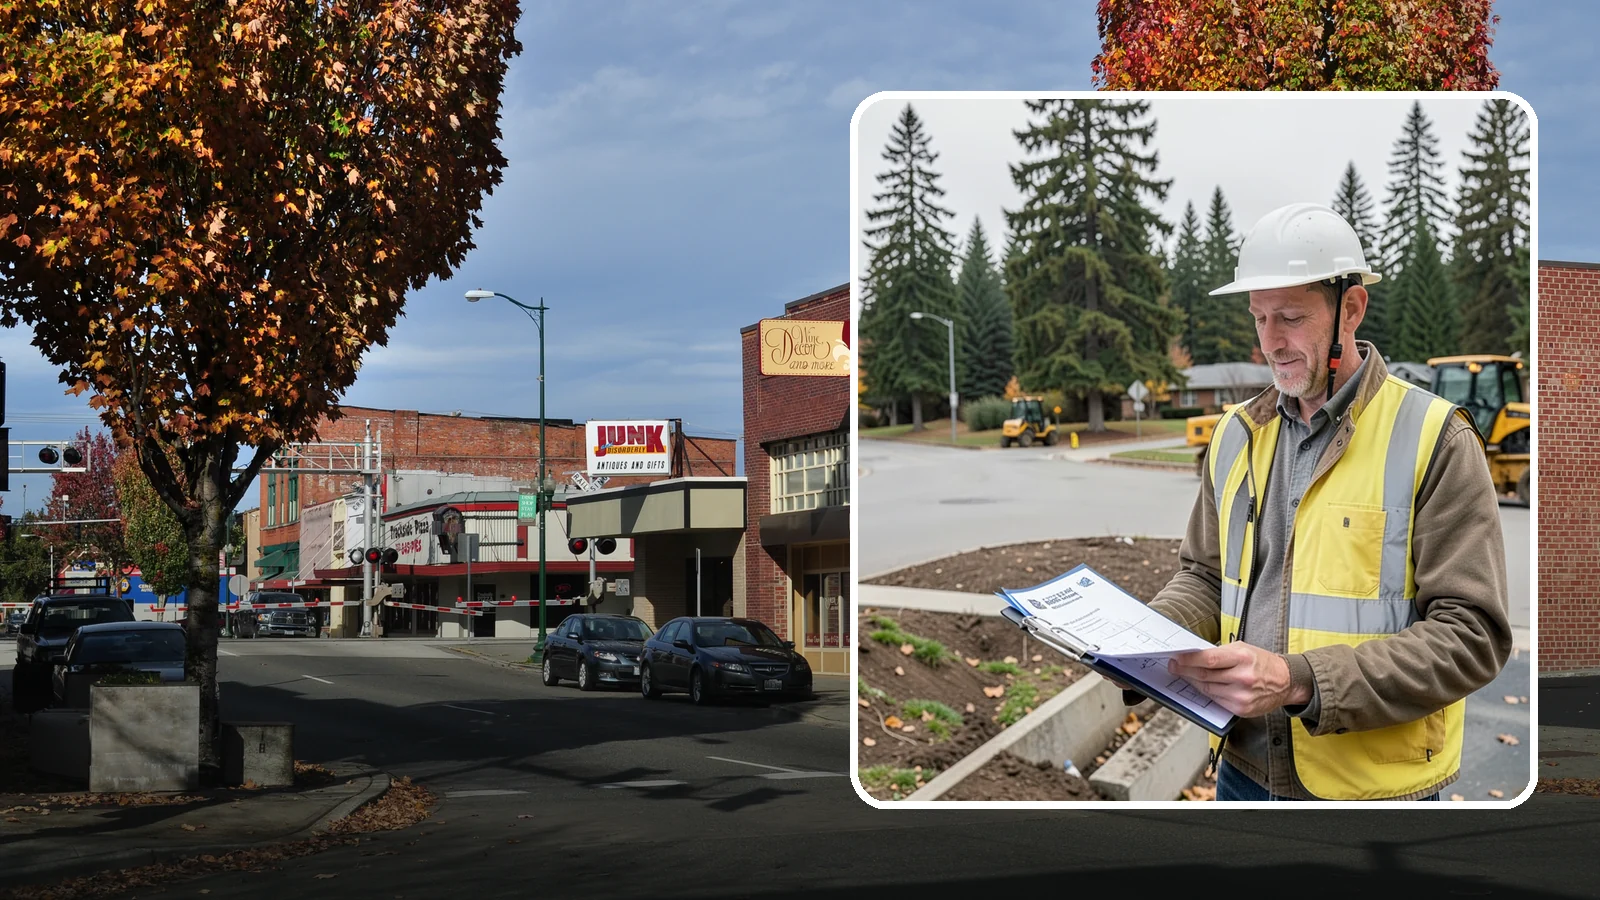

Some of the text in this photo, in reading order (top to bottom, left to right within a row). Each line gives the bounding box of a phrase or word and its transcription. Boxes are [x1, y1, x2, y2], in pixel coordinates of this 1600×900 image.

[595, 425, 665, 457] JUNK
[607, 446, 645, 454] DISORDERLY
[597, 460, 665, 470] ANTIQUES AND GIFTS
[573, 473, 589, 491] RAIL
[414, 520, 429, 535] Pizza
